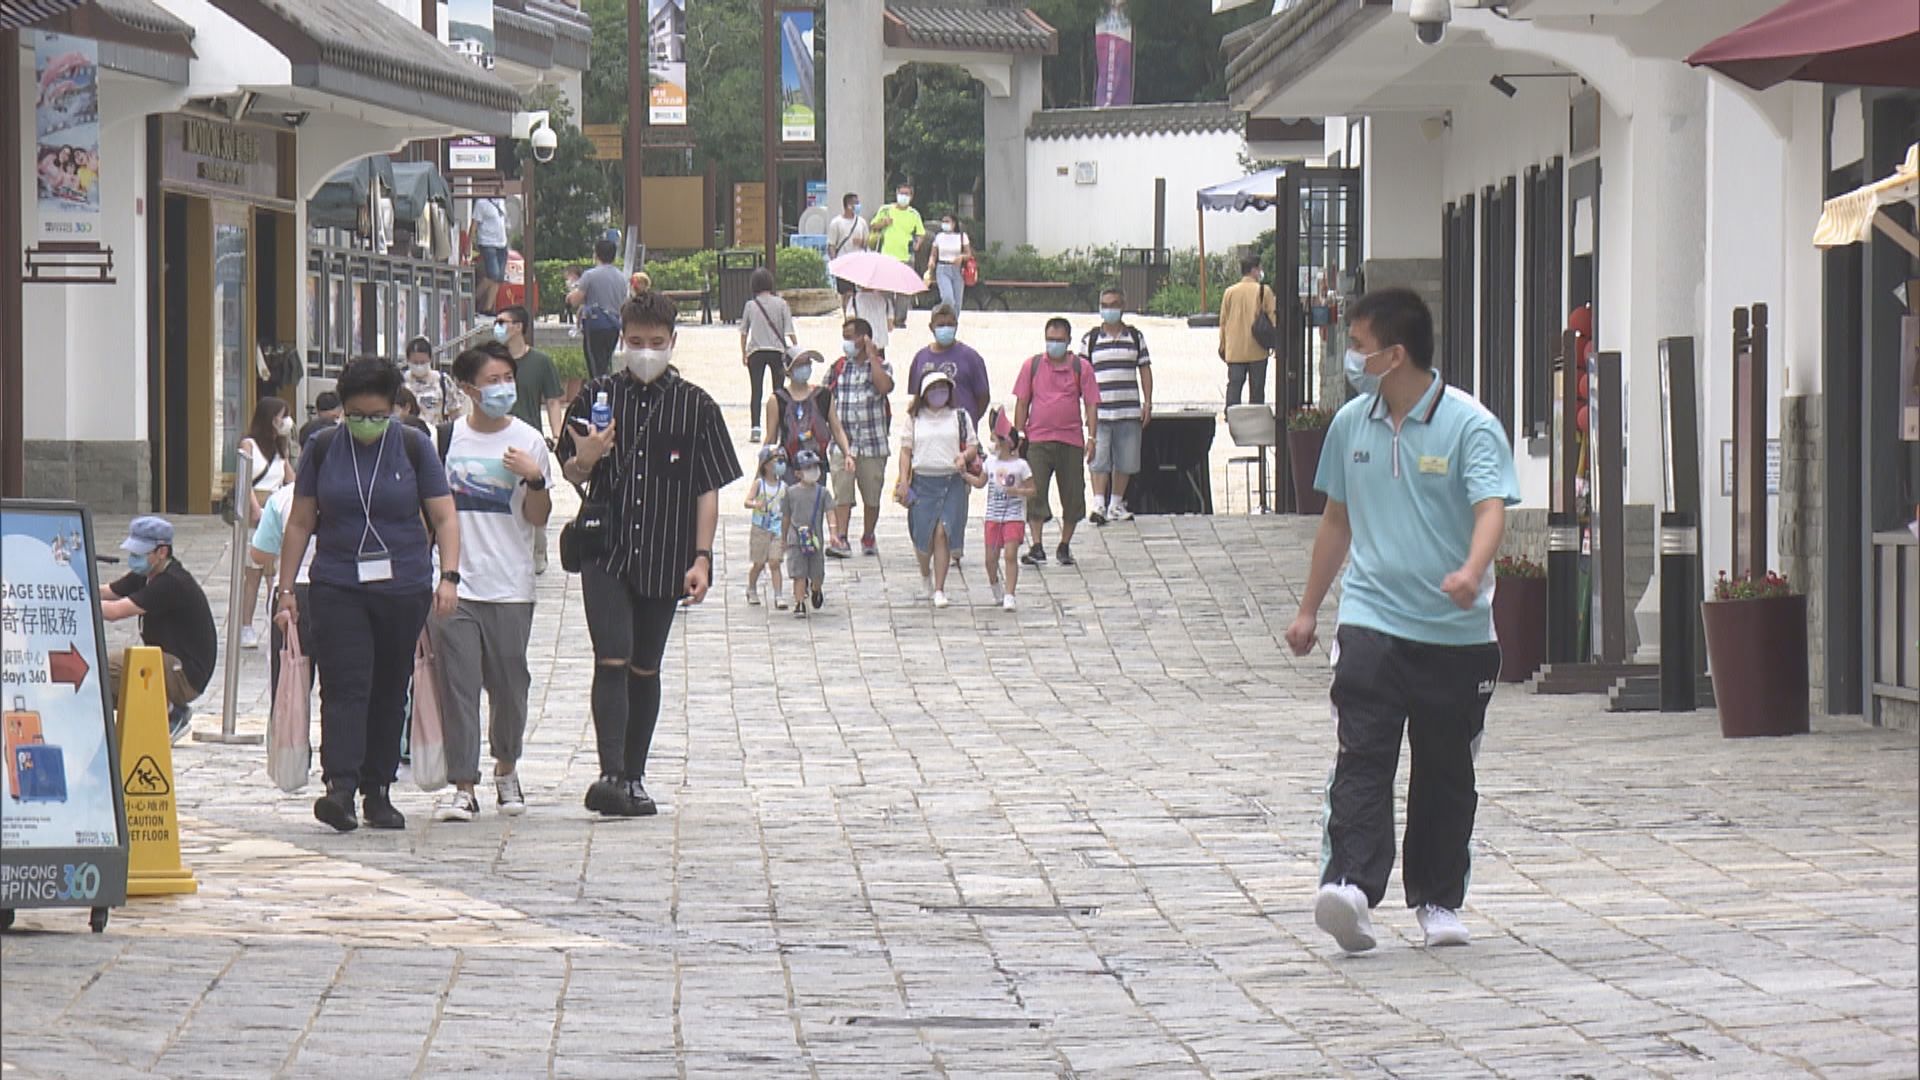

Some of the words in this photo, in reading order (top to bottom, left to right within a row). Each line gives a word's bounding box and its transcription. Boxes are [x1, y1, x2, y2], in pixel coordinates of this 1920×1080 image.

[37, 584, 85, 601] SERVICE
[2, 605, 77, 635] 寄存服務
[2, 669, 26, 686] days
[29, 670, 47, 683] 360
[128, 815, 164, 826] CAUTION
[129, 830, 140, 841] ET
[143, 830, 169, 841] FLOOR
[10, 865, 57, 880] NGONG
[57, 862, 100, 900] 360
[9, 881, 57, 900] PING
